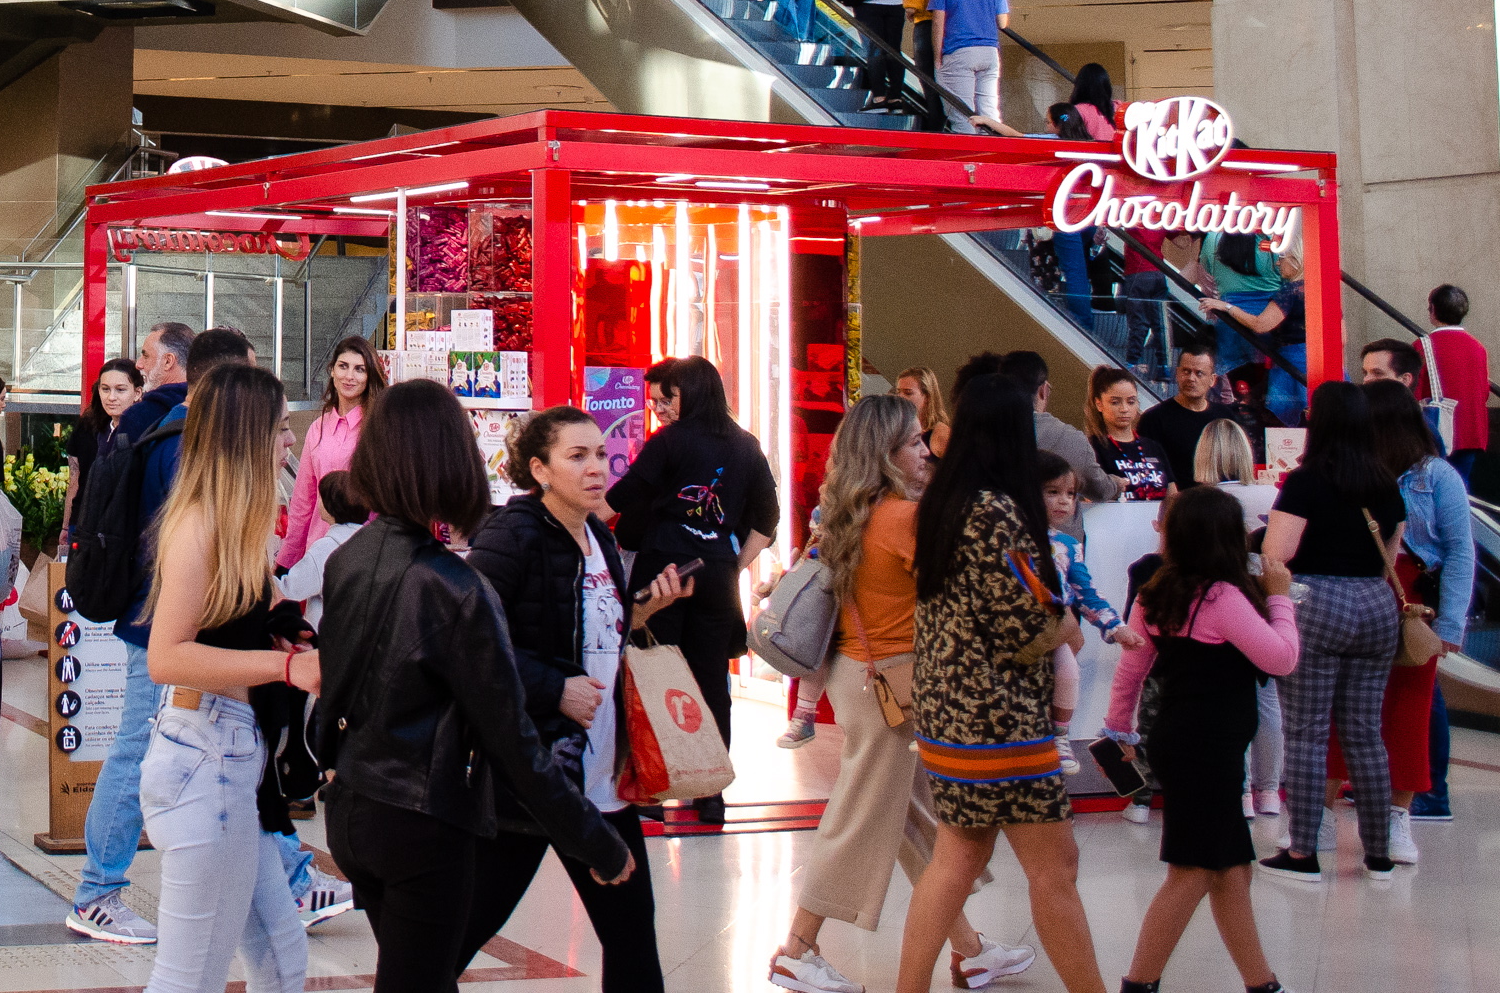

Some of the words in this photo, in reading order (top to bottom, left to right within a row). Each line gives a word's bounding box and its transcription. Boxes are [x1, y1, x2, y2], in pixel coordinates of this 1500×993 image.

[1125, 97, 1228, 179] KitKat
[1053, 162, 1297, 254] Chocolatory
[585, 396, 635, 411] Toronto
